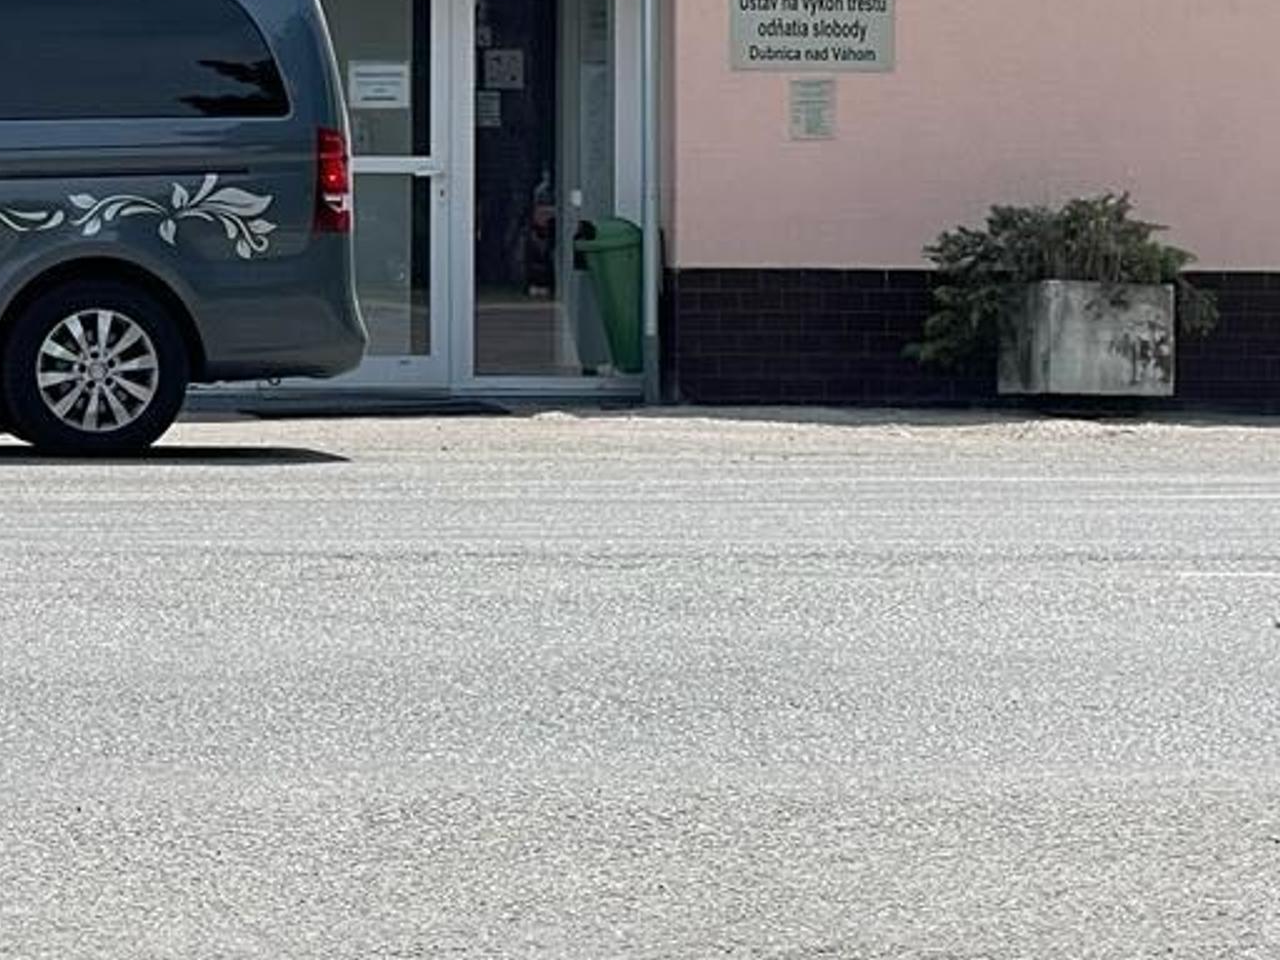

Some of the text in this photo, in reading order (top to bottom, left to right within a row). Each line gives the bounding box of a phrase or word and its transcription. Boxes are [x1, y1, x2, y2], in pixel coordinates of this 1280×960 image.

[757, 18, 867, 41] odňatia slobody
[749, 46, 801, 61] Dubnica
[805, 46, 828, 61] nad
